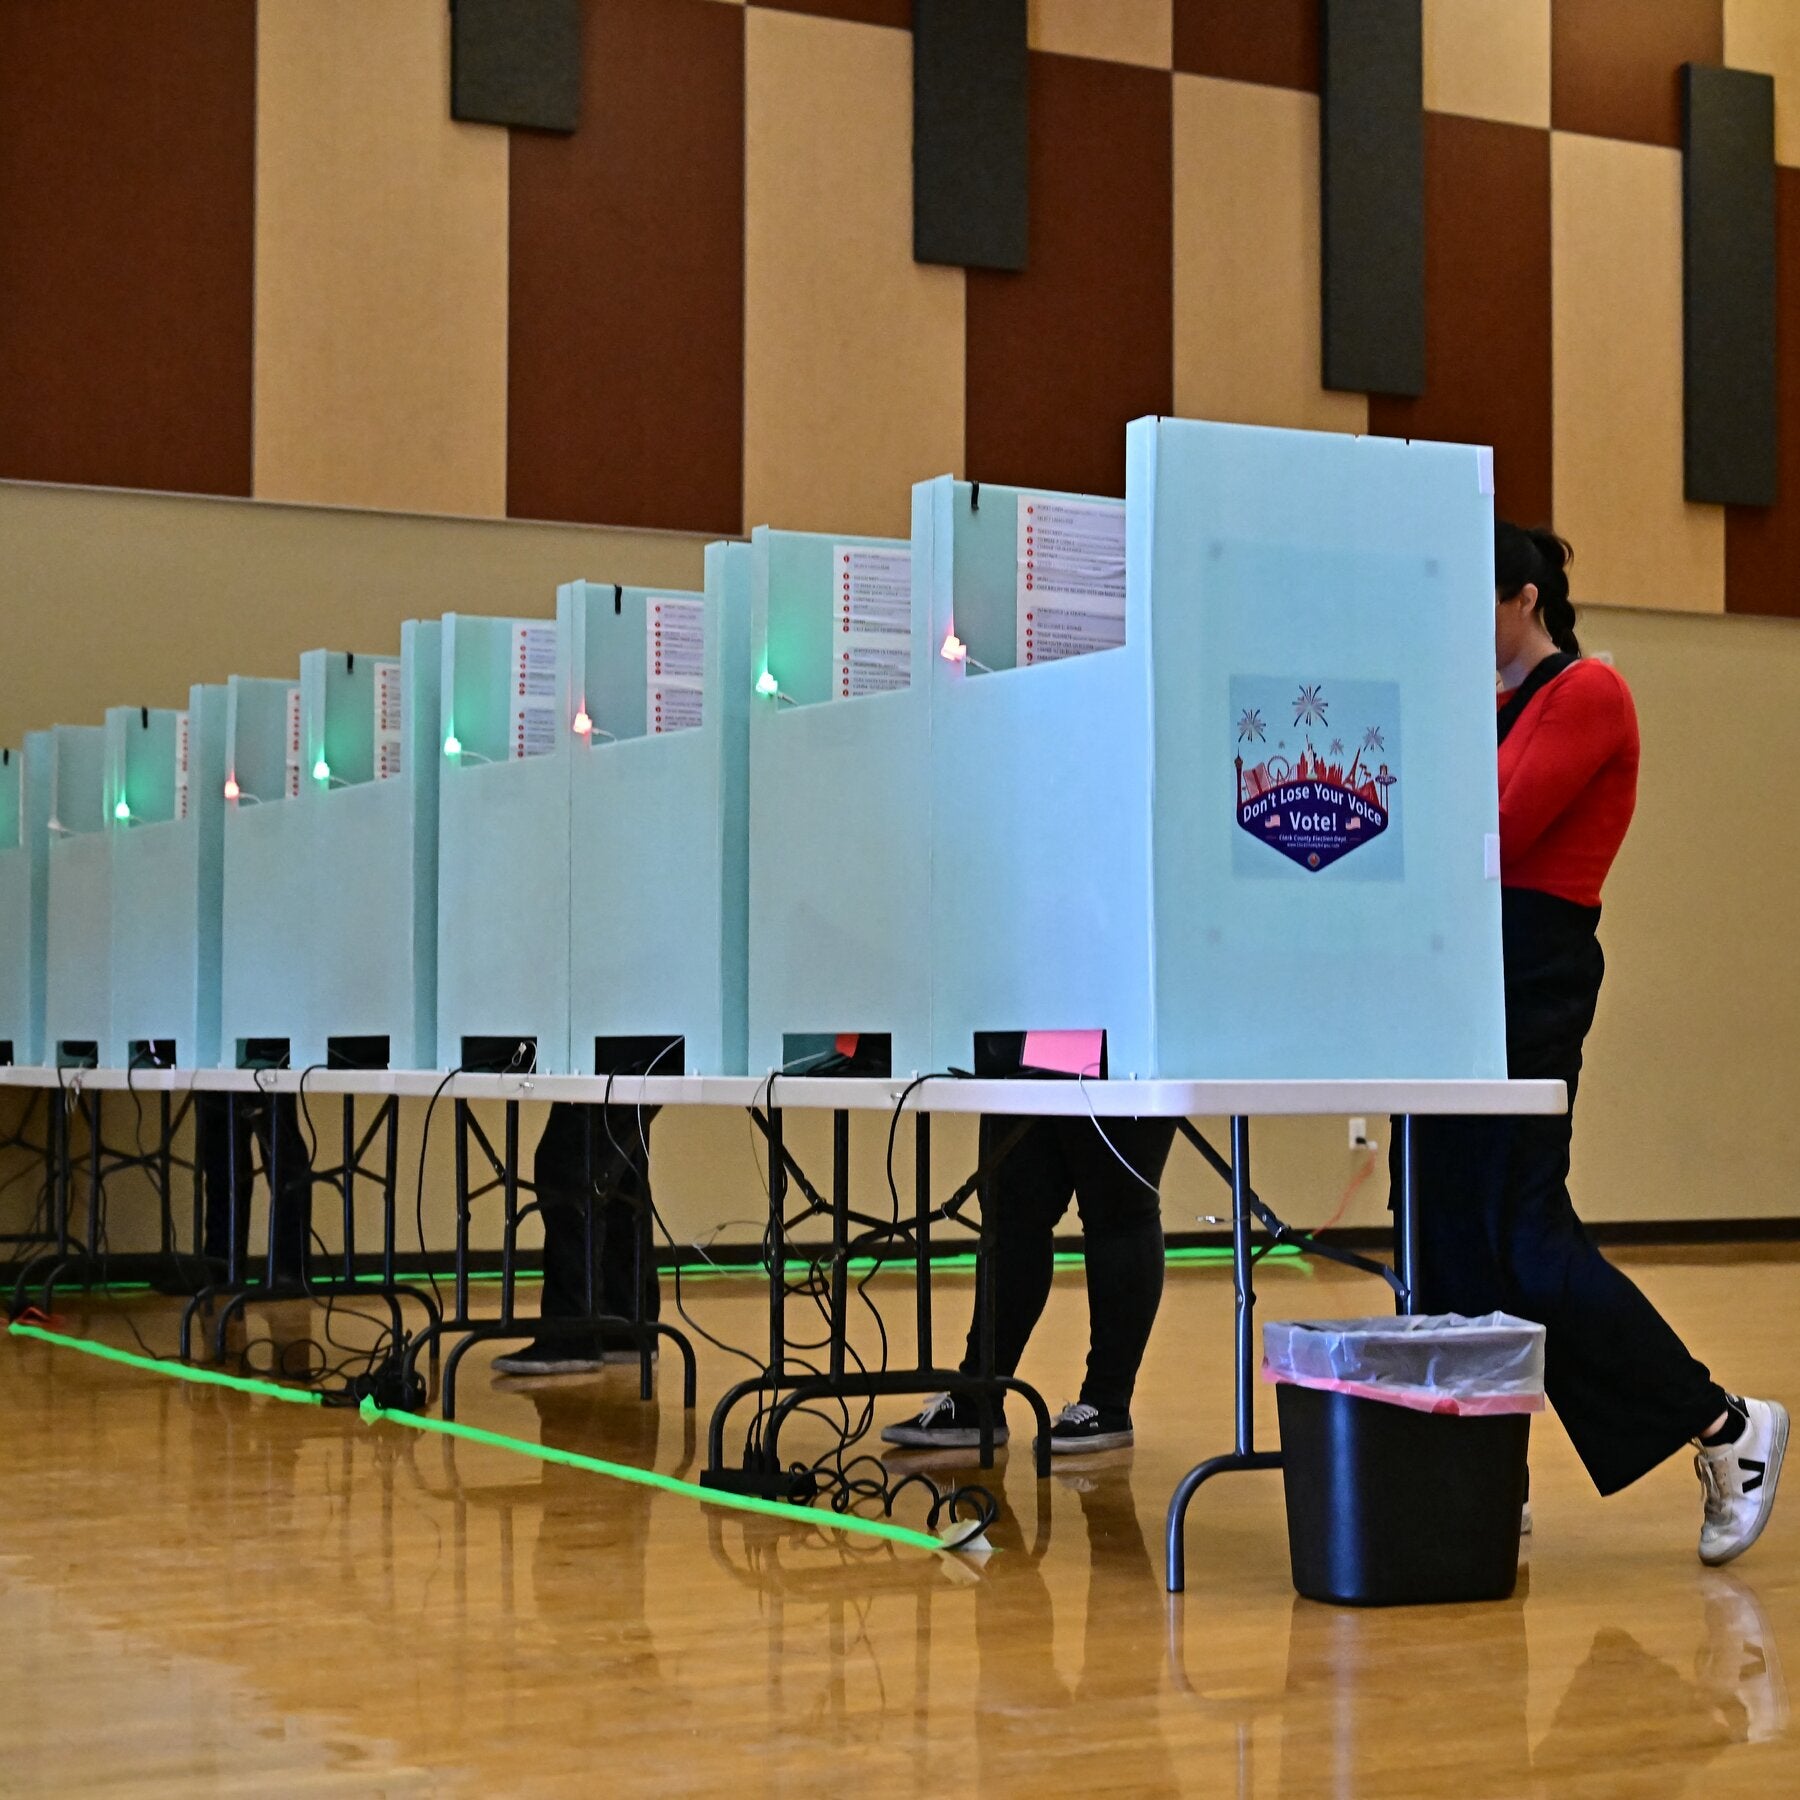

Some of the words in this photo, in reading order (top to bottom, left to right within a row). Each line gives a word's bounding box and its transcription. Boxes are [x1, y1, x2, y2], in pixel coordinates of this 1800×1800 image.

[1243, 793, 1276, 823] Don't
[1280, 785, 1310, 804] Lose
[1314, 783, 1344, 805] Your
[1348, 793, 1382, 826] Voice
[1289, 811, 1337, 831] Vote!
